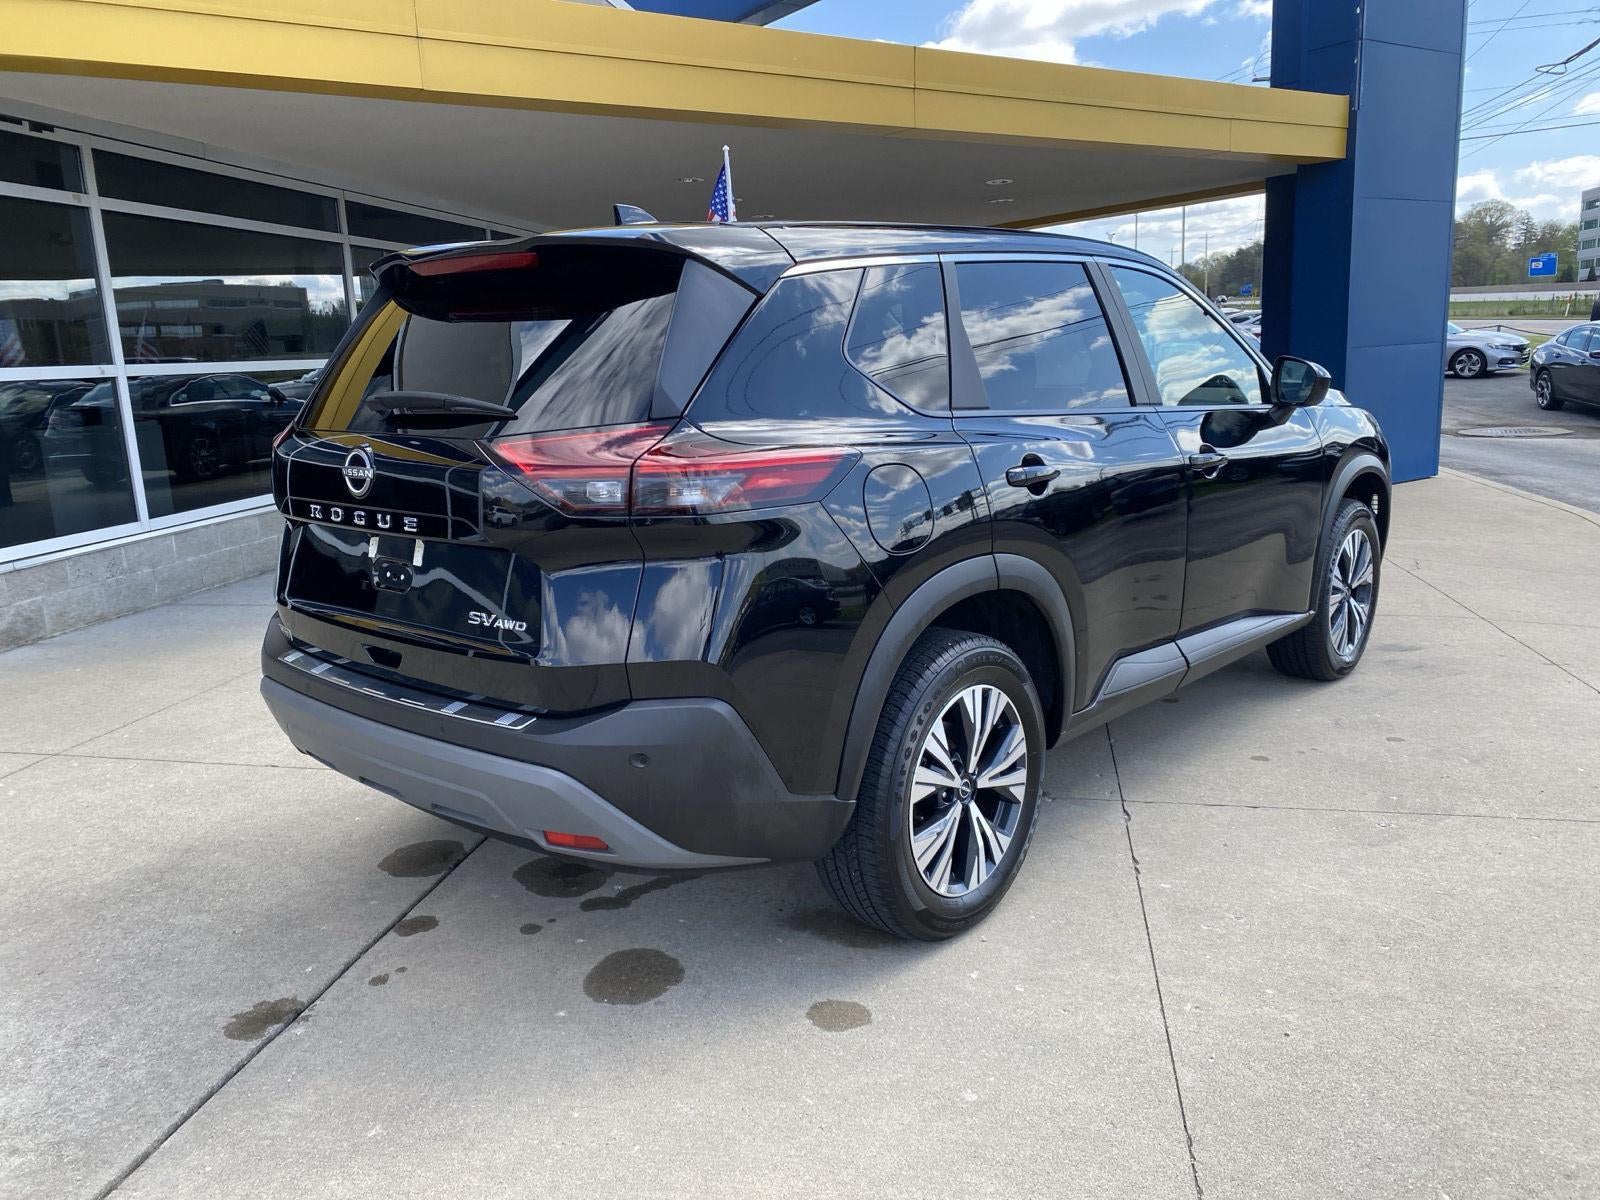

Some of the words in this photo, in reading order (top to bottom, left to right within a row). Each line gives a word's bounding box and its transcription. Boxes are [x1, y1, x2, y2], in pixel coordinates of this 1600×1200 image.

[342, 467, 373, 479] NISSAN
[309, 504, 418, 532] ROGUE
[467, 611, 496, 626] SV
[494, 618, 526, 631] AWD
